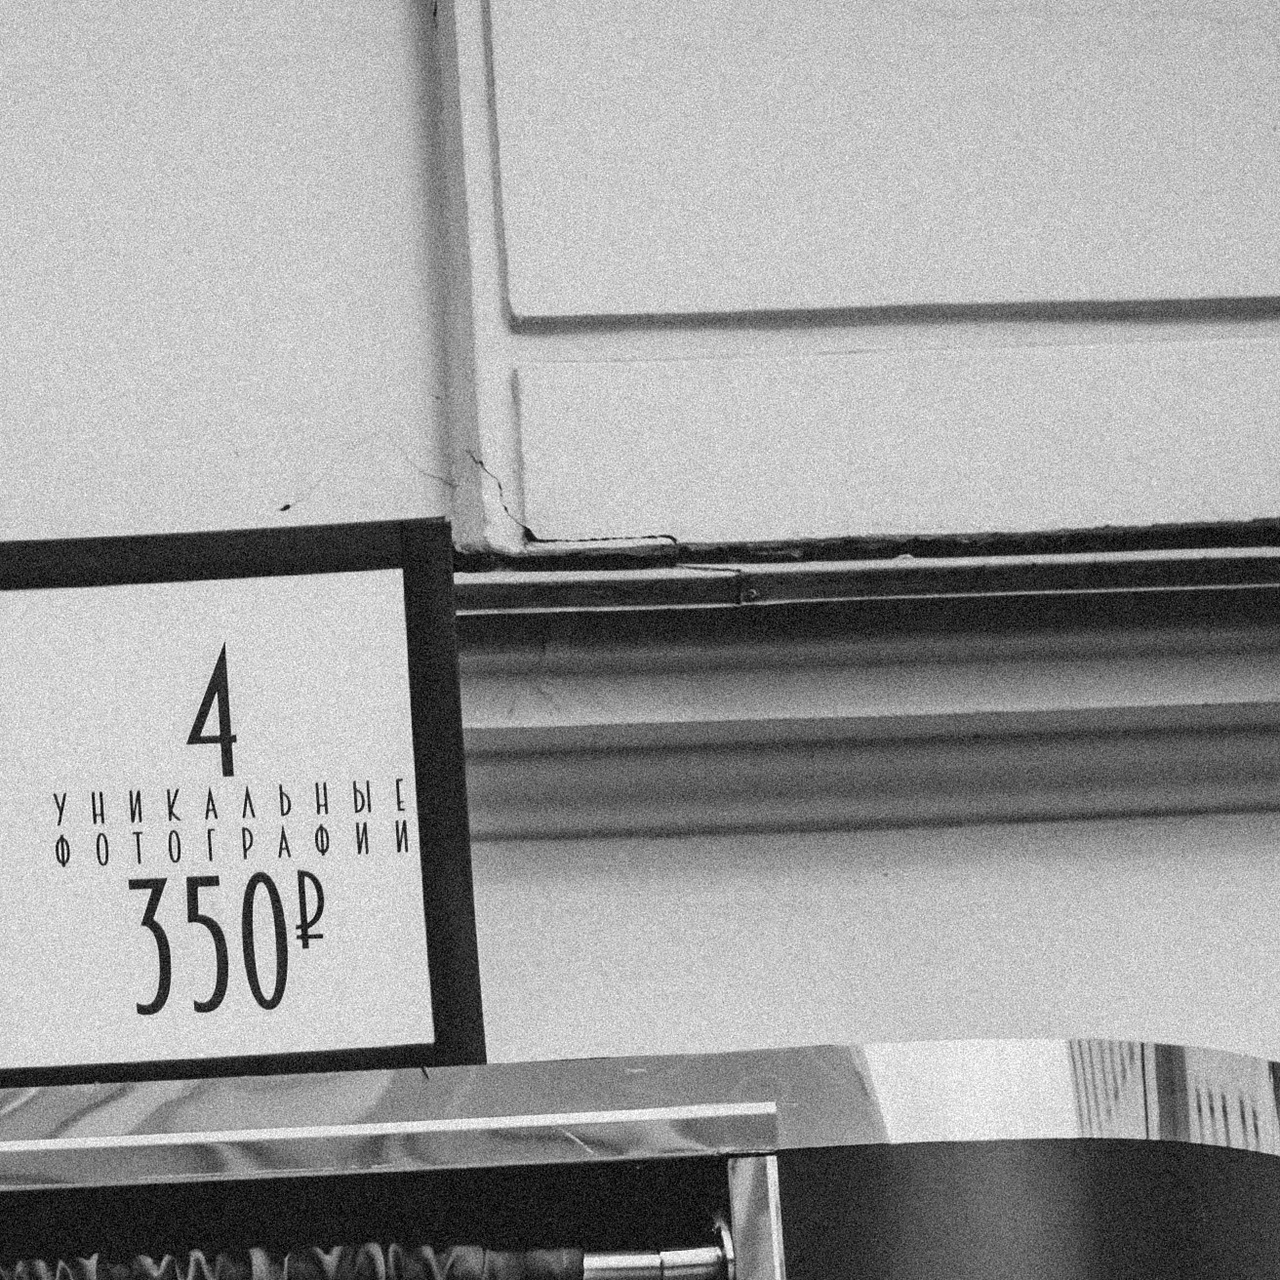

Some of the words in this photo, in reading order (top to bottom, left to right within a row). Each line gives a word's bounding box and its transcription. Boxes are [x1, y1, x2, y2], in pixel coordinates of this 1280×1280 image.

[187, 642, 237, 777] 4
[54, 779, 405, 824] УНИКАЛЬНЫЕ
[55, 821, 408, 867] ФОТОГРАФИИ
